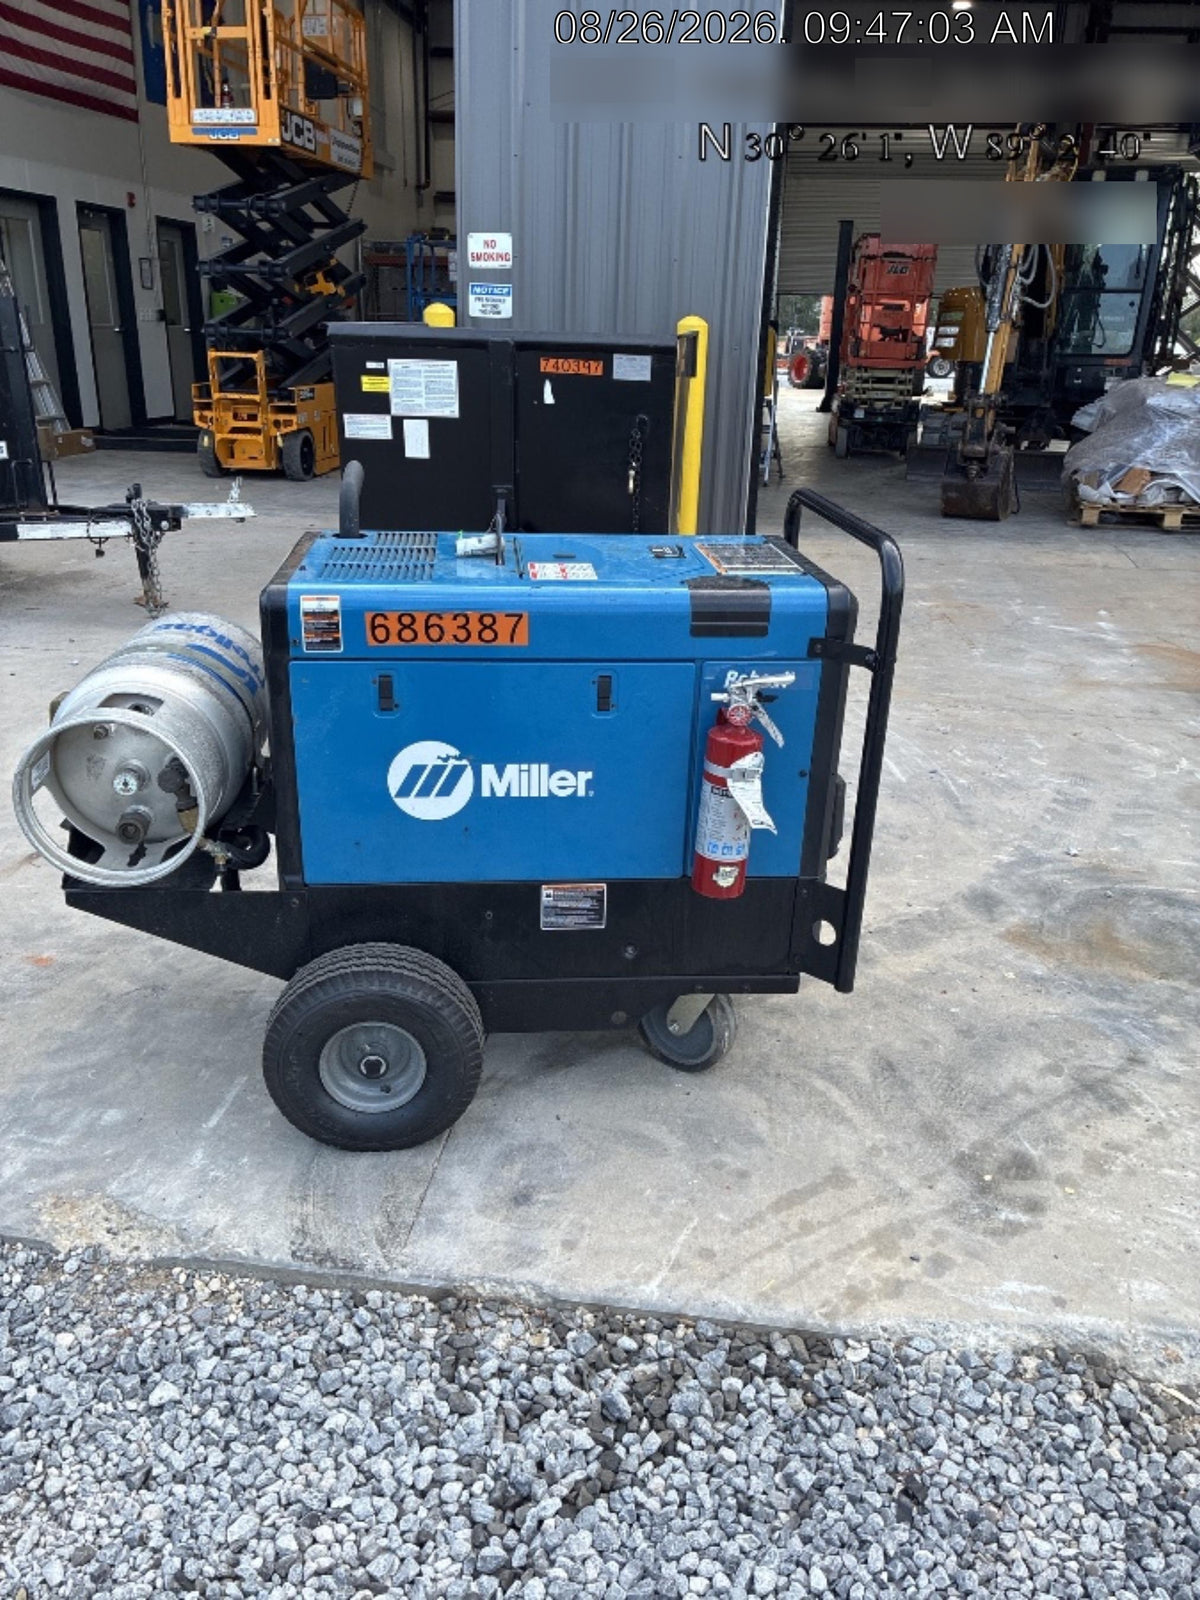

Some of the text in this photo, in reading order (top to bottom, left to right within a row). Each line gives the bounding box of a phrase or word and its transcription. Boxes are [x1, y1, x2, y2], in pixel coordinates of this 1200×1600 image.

[281, 112, 316, 151] JCB
[470, 251, 511, 262] SMOKING
[482, 239, 497, 250] NO
[369, 612, 524, 644] 686387
[481, 763, 594, 798] Miller
